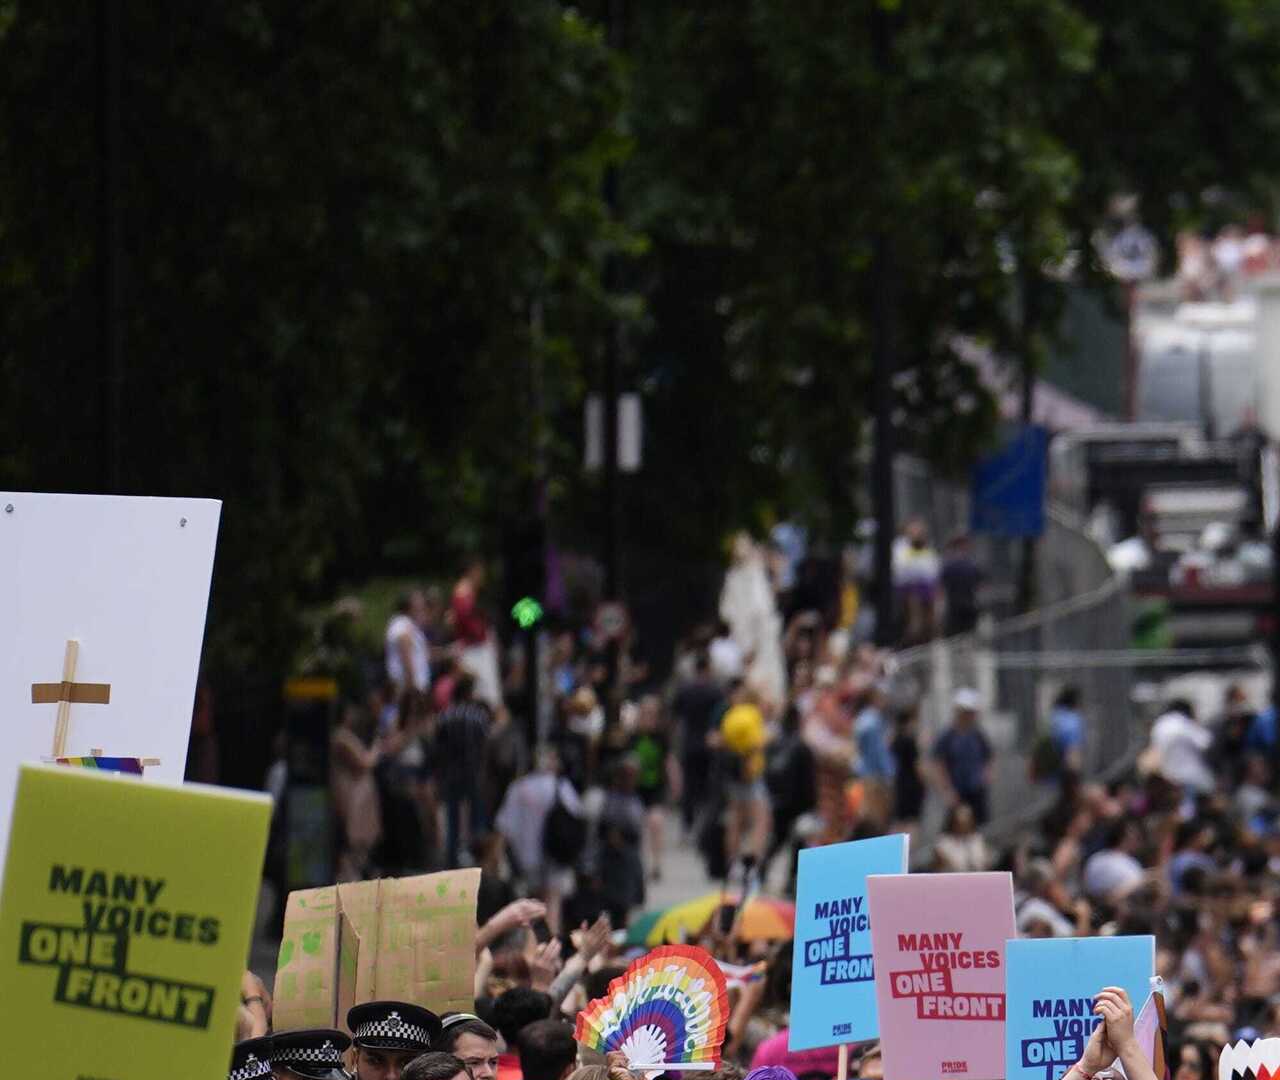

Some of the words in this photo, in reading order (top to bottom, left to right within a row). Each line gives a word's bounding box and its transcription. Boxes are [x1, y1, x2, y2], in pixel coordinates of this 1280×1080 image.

[50, 863, 166, 905] MANY
[815, 896, 863, 919] MANY
[83, 902, 220, 945] VOICES
[829, 914, 872, 936] VOIC
[28, 926, 118, 968] ONE
[808, 936, 845, 960] ONE
[898, 932, 962, 951] MANY
[825, 957, 874, 982] FRON
[920, 951, 1000, 970] VOICES
[65, 966, 208, 1022] FRONT
[896, 972, 945, 993] ONE
[923, 997, 1002, 1017] FRONT
[1033, 999, 1098, 1017] MANY
[1027, 1040, 1076, 1063] ONE
